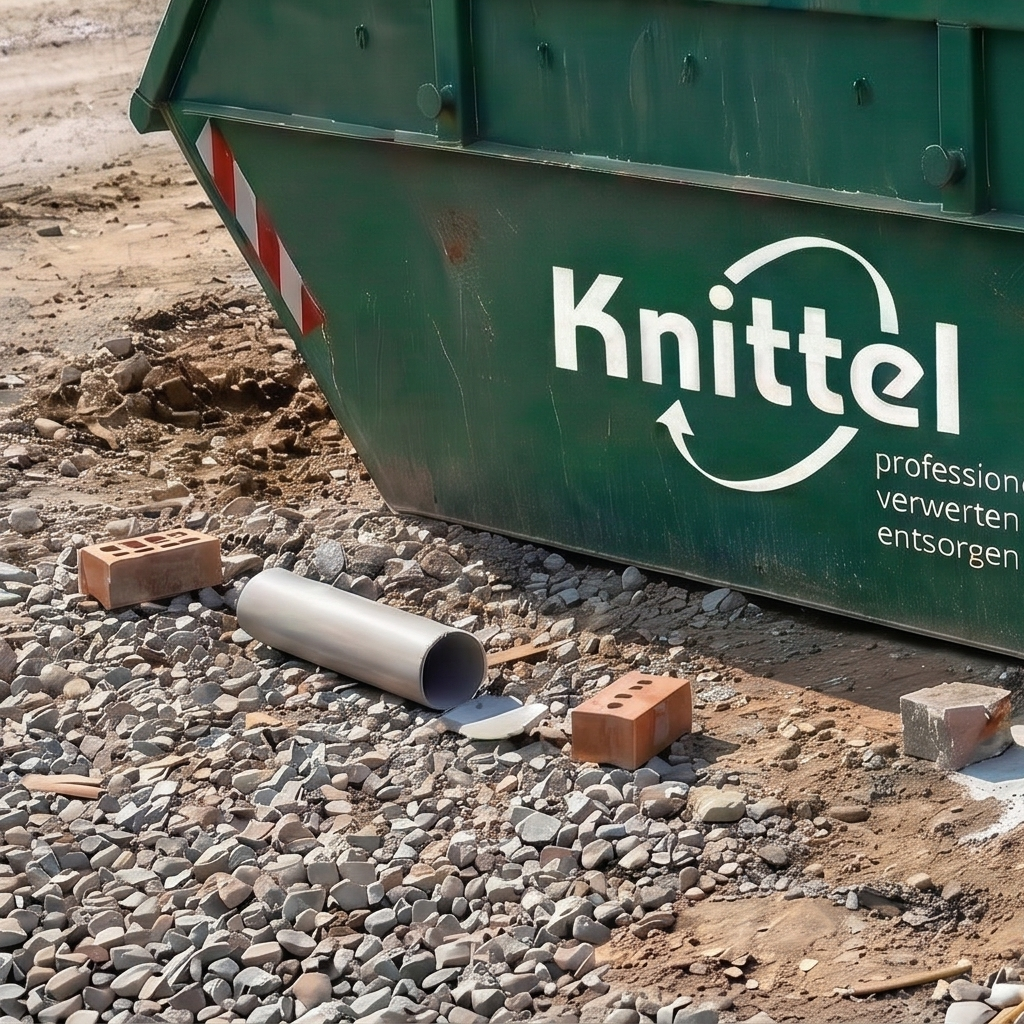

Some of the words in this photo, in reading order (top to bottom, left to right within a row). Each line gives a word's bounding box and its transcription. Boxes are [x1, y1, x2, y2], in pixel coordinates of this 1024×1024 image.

[552, 265, 960, 436] Knittel
[876, 489, 1019, 532] verwerten
[877, 526, 1019, 570] entsorgen
